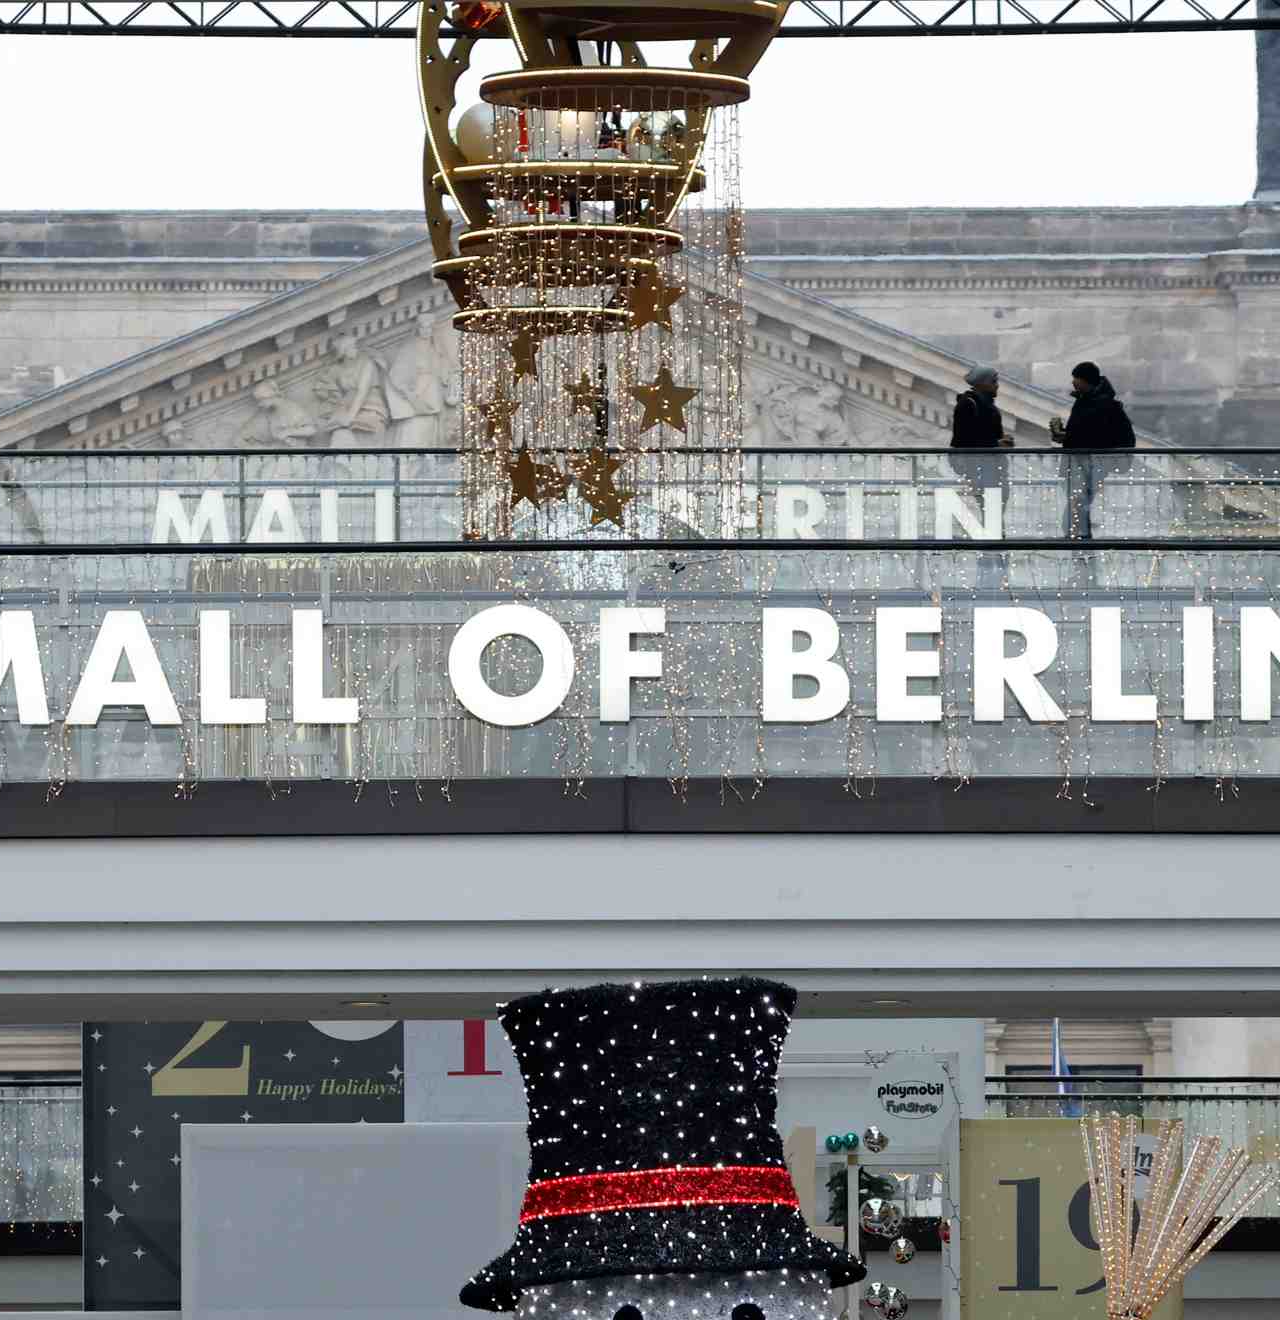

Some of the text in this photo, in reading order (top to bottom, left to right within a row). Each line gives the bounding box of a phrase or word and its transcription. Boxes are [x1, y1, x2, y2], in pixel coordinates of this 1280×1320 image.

[448, 603, 666, 726] OF
[257, 1077, 404, 1101] Happy Holidays!
[877, 1083, 944, 1099] playmobil
